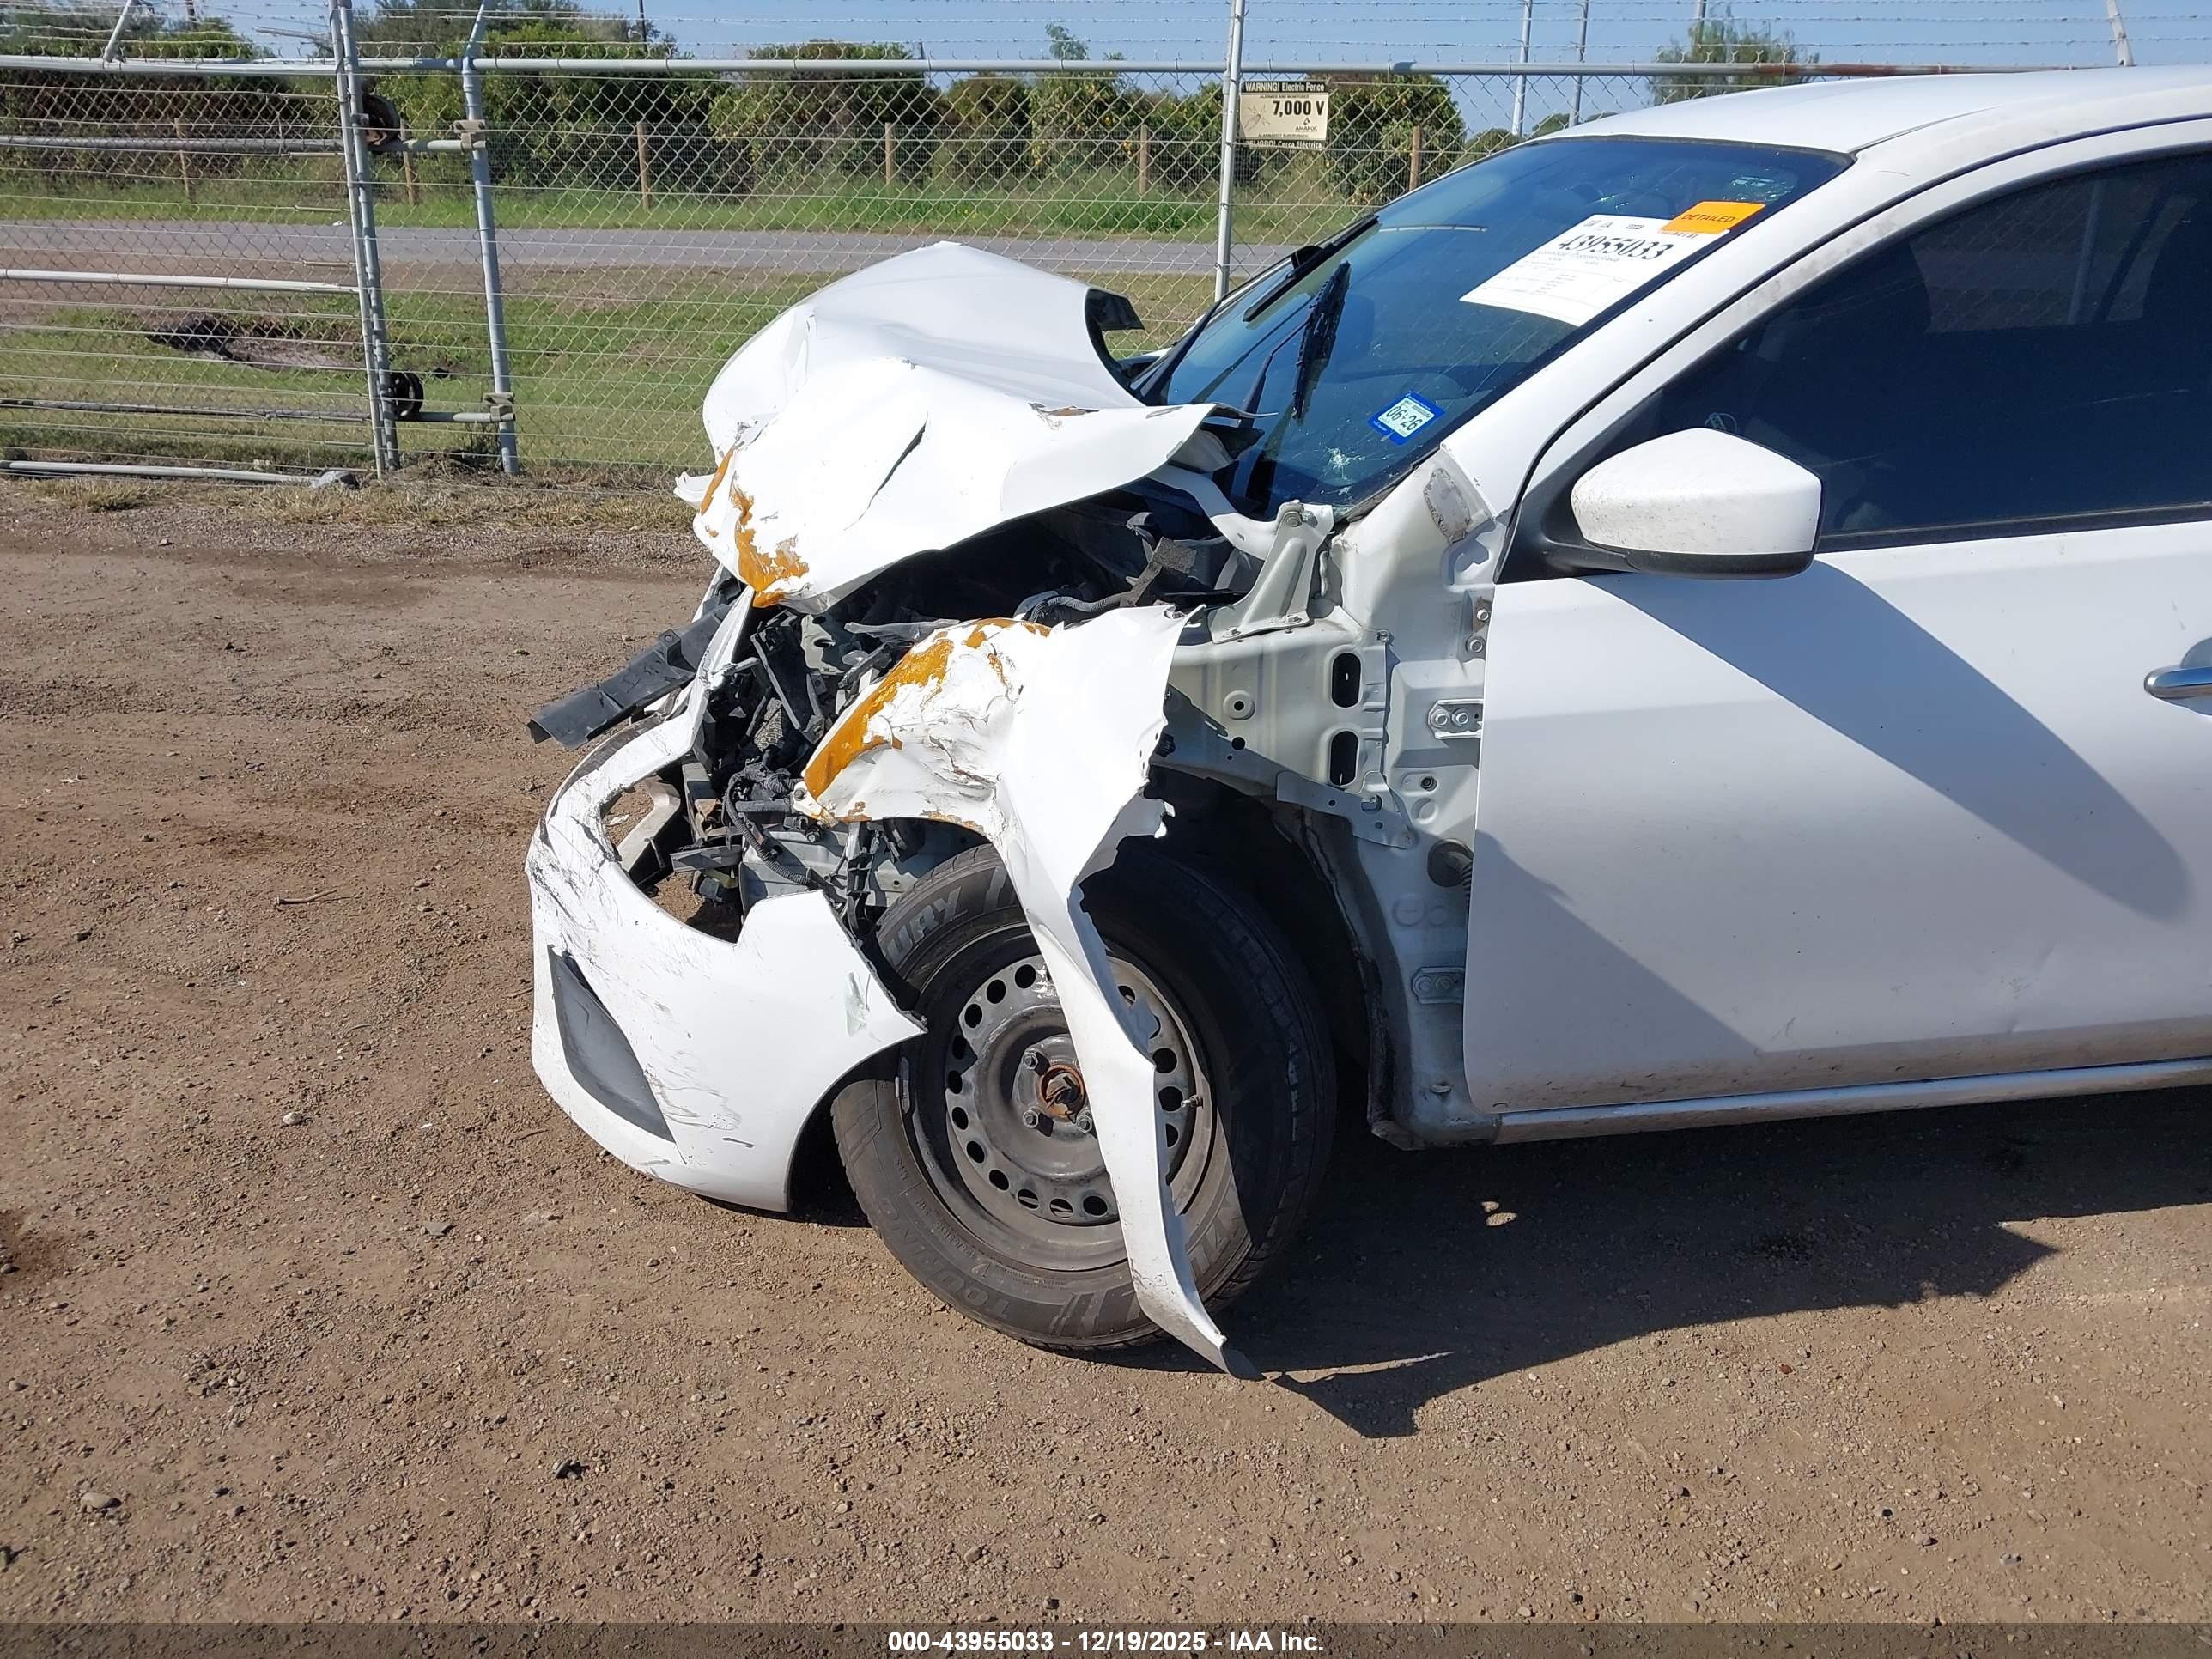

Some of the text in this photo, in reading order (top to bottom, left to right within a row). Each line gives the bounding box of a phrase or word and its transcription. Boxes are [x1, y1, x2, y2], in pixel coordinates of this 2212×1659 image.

[1245, 82, 1325, 92] WARNING! Electric Fence
[1273, 100, 1325, 118] 7,000 V
[1278, 140, 1295, 149] Cerca
[1681, 213, 1736, 223] DETAILED
[1559, 234, 1674, 260] 43955033
[1386, 405, 1407, 421] 06
[1400, 415, 1423, 431] 26
